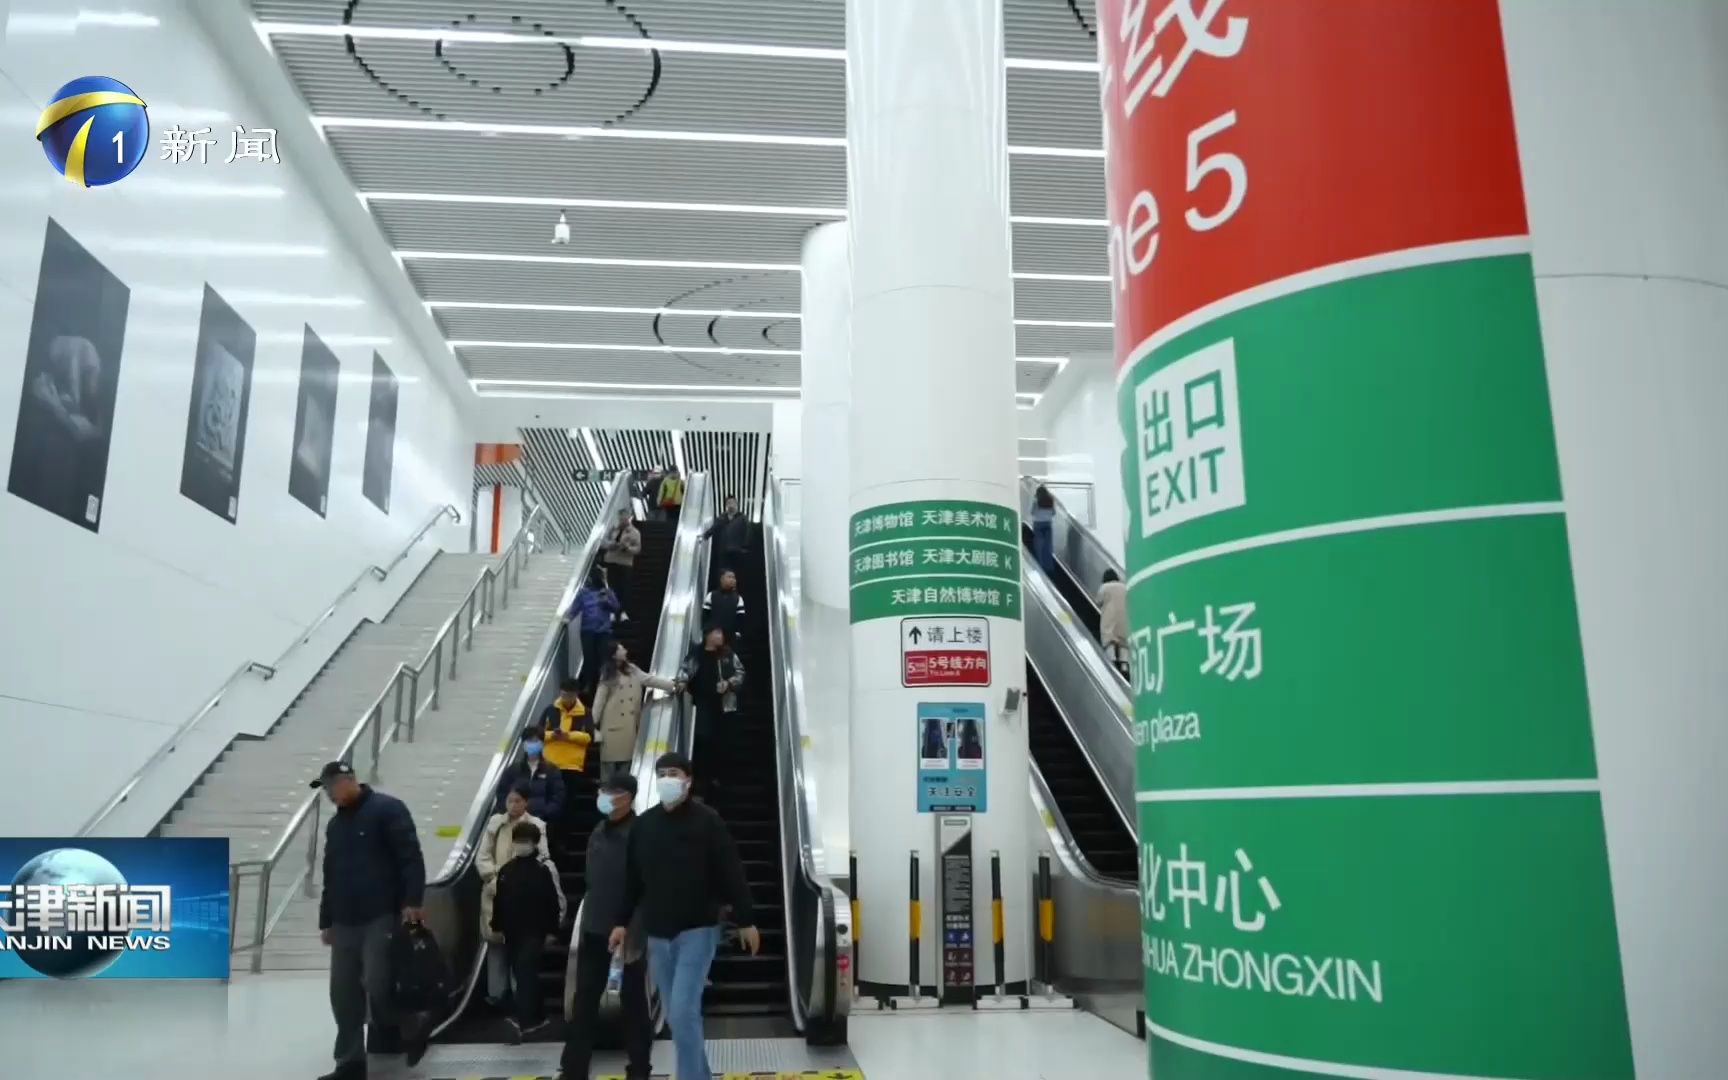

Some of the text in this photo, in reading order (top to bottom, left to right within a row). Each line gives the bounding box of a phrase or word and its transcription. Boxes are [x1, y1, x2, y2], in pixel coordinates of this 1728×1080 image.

[1120, 0, 1249, 119] 线
[1108, 109, 1248, 291] ne 5
[1143, 369, 1225, 461] 出口
[1146, 447, 1225, 517] EXIT
[854, 510, 1012, 537] 天津博物馆 天津美术馆 K
[854, 548, 1013, 574] 天津图书馆 天津大剧院 K
[891, 586, 1001, 606] 天津自然博物馆
[926, 626, 983, 644] 请上楼
[928, 656, 986, 670] 5号线方向
[1151, 708, 1201, 753] plaza
[1140, 842, 1282, 932] 化中心
[1143, 931, 1383, 1003] HUA ZHONGXIN
